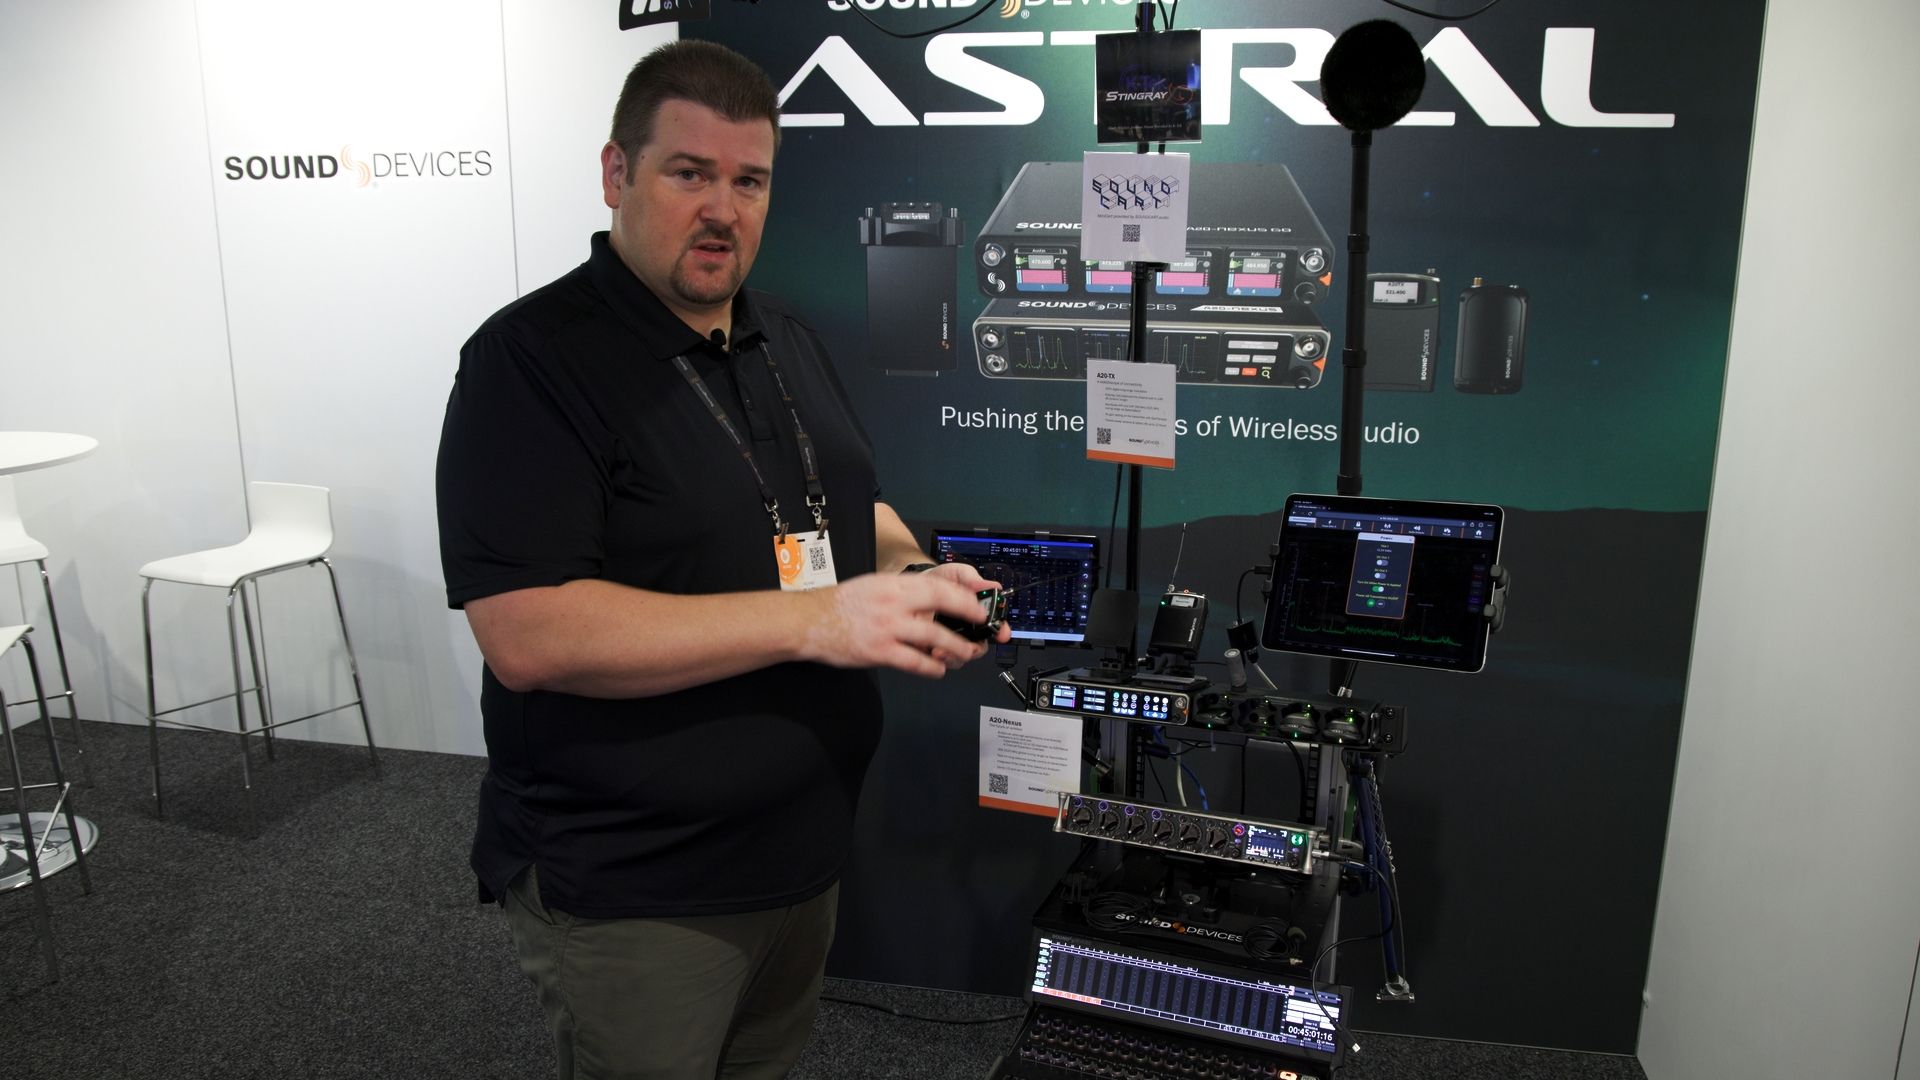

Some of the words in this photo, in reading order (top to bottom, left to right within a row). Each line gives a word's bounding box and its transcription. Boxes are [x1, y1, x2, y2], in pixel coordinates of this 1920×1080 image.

[778, 27, 1676, 128] ASRAL
[224, 154, 339, 181] SOUND
[372, 150, 492, 178] DEVICES
[1092, 178, 1171, 196] SOUND
[1100, 193, 1162, 211] CART
[1018, 300, 1087, 309] SOUND
[1106, 302, 1177, 311] DECES
[1420, 357, 1428, 381] SOUND
[941, 405, 1038, 435] Pushing
[1044, 409, 1085, 432] the
[1196, 415, 1223, 437] of
[1229, 415, 1338, 442] Wireless
[1364, 421, 1420, 445] udio
[989, 716, 1022, 727] A20-Nexus
[1186, 926, 1243, 943] DEVICES
[1288, 1025, 1333, 1041] 00:45:01:16
